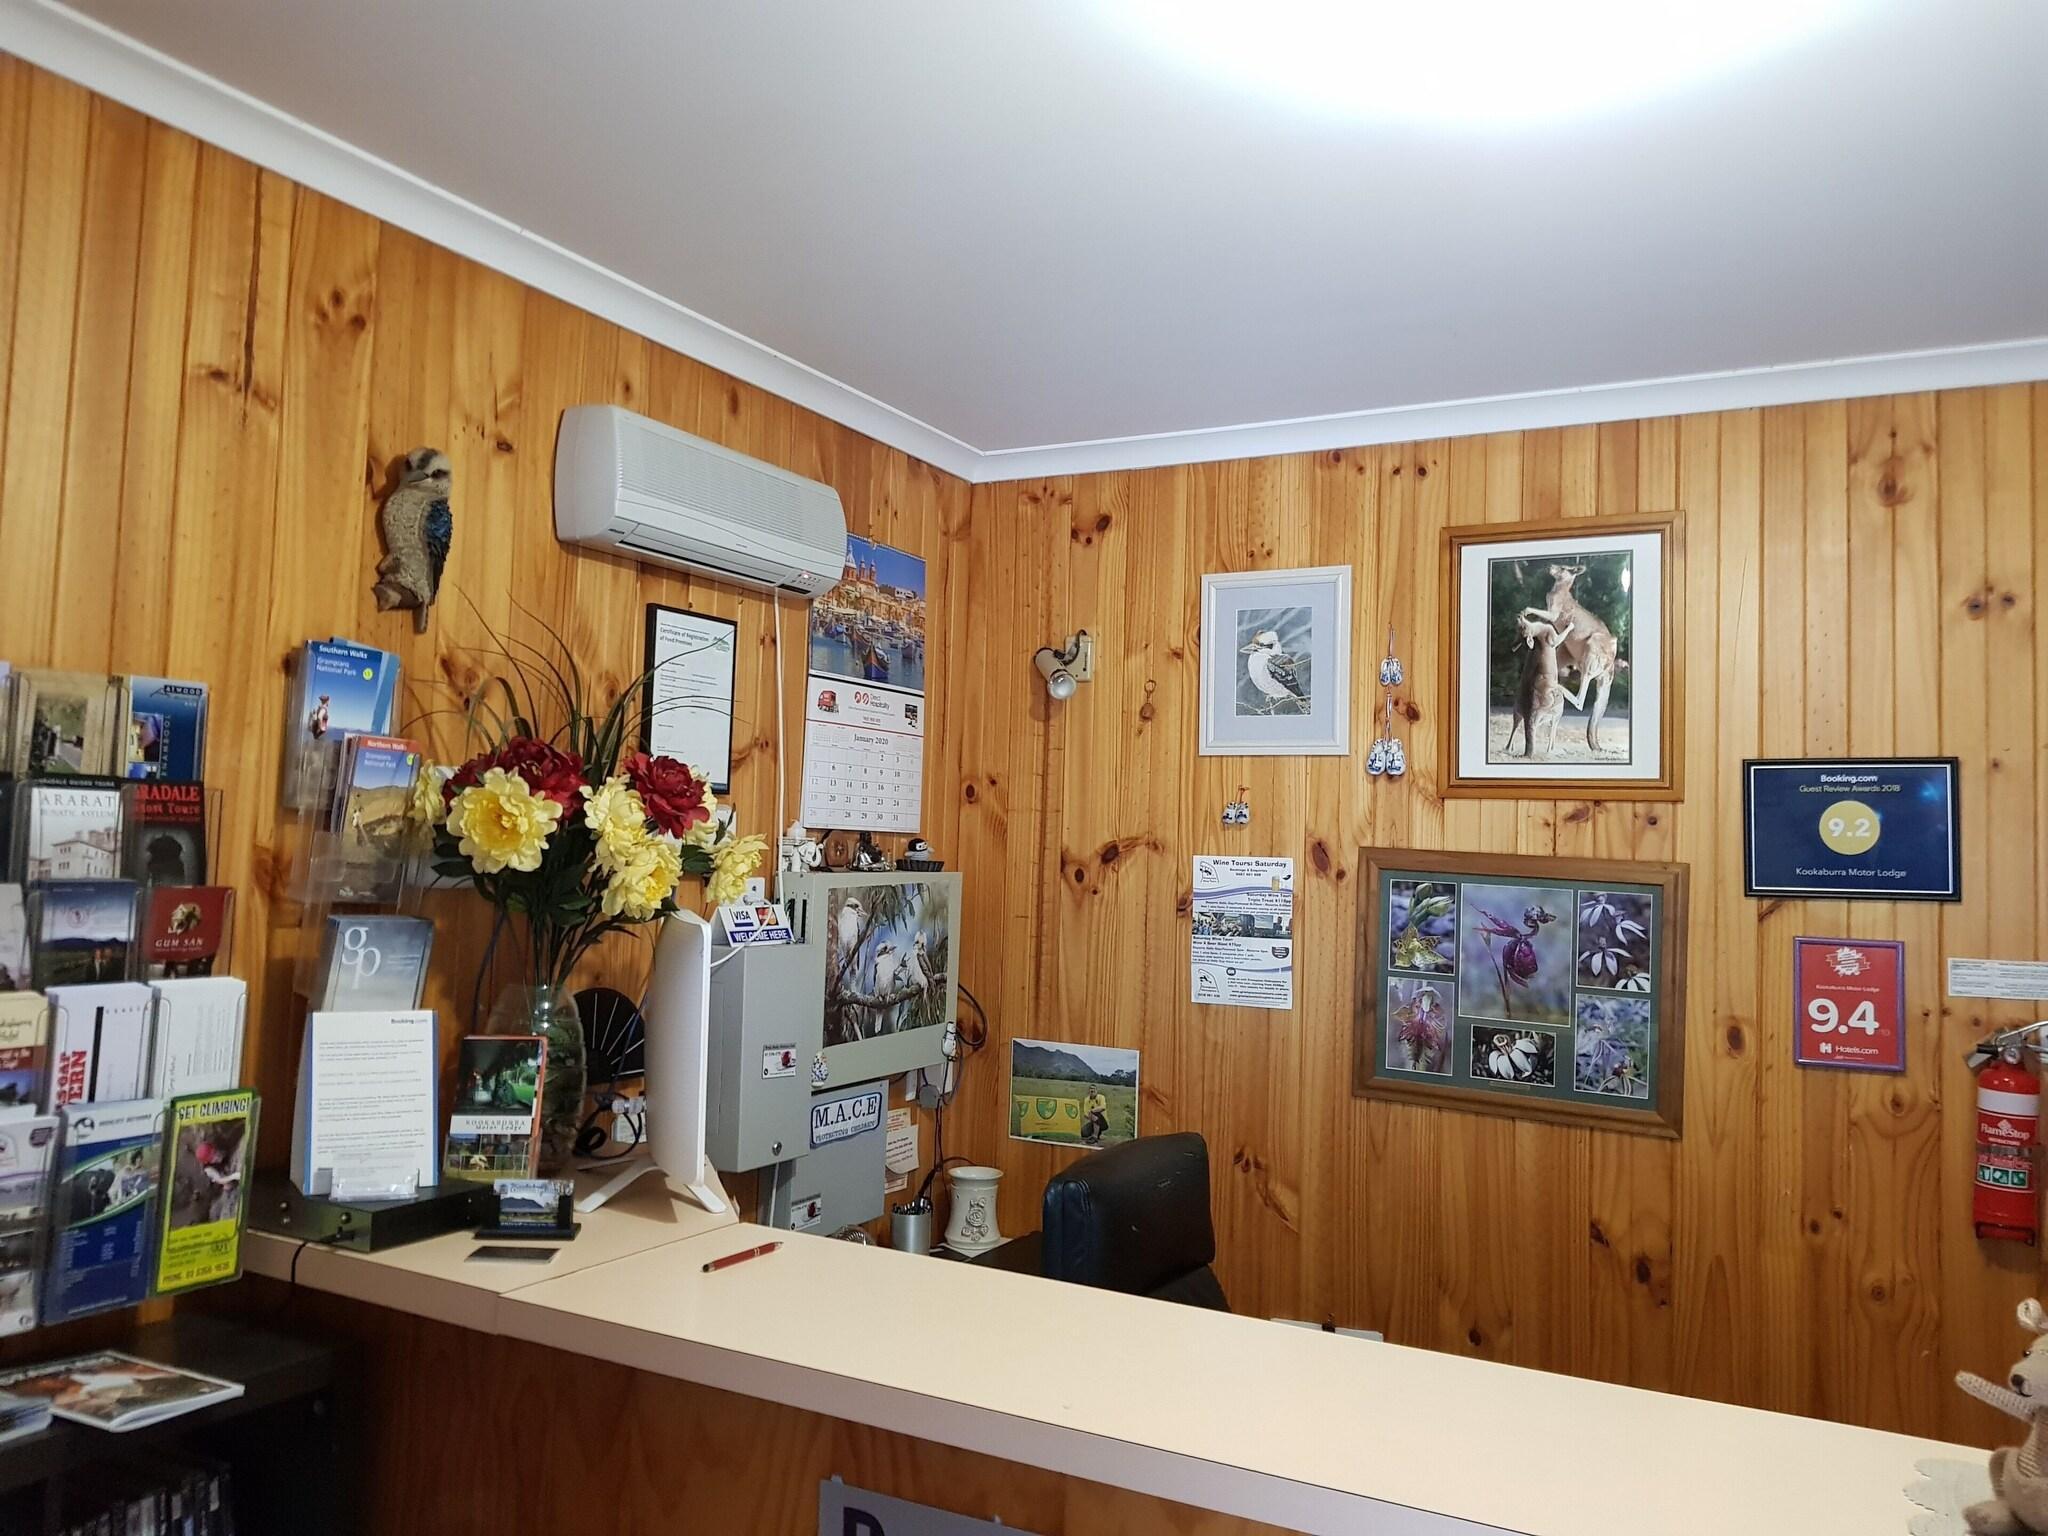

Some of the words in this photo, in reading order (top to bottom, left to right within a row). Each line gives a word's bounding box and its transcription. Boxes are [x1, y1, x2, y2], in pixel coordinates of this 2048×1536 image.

[319, 645, 348, 656] Southern
[350, 649, 368, 659] Walks
[317, 664, 343, 673] National
[854, 734, 874, 745] January
[1820, 774, 1878, 784] Booking.com
[1799, 785, 1823, 793] Guest
[1881, 784, 1900, 792] 2018
[41, 793, 115, 808] ARARAT
[1828, 817, 1871, 838] 9.2
[1255, 860, 1287, 868] Saturday
[1796, 867, 1846, 877] Kookaburra
[1848, 868, 1875, 877] Motor
[1877, 868, 1906, 879] Lodge
[733, 911, 751, 920] VISA
[733, 931, 769, 942] WELCOME
[769, 929, 788, 939] HERE
[156, 938, 179, 948] GUM
[183, 937, 204, 947] SAN
[1808, 998, 1880, 1036] 9.4
[1836, 1045, 1879, 1055] Hotels.com
[179, 1103, 196, 1121] GET
[200, 1097, 250, 1117] CLIMBING!
[814, 1096, 877, 1129] M.A.C.E
